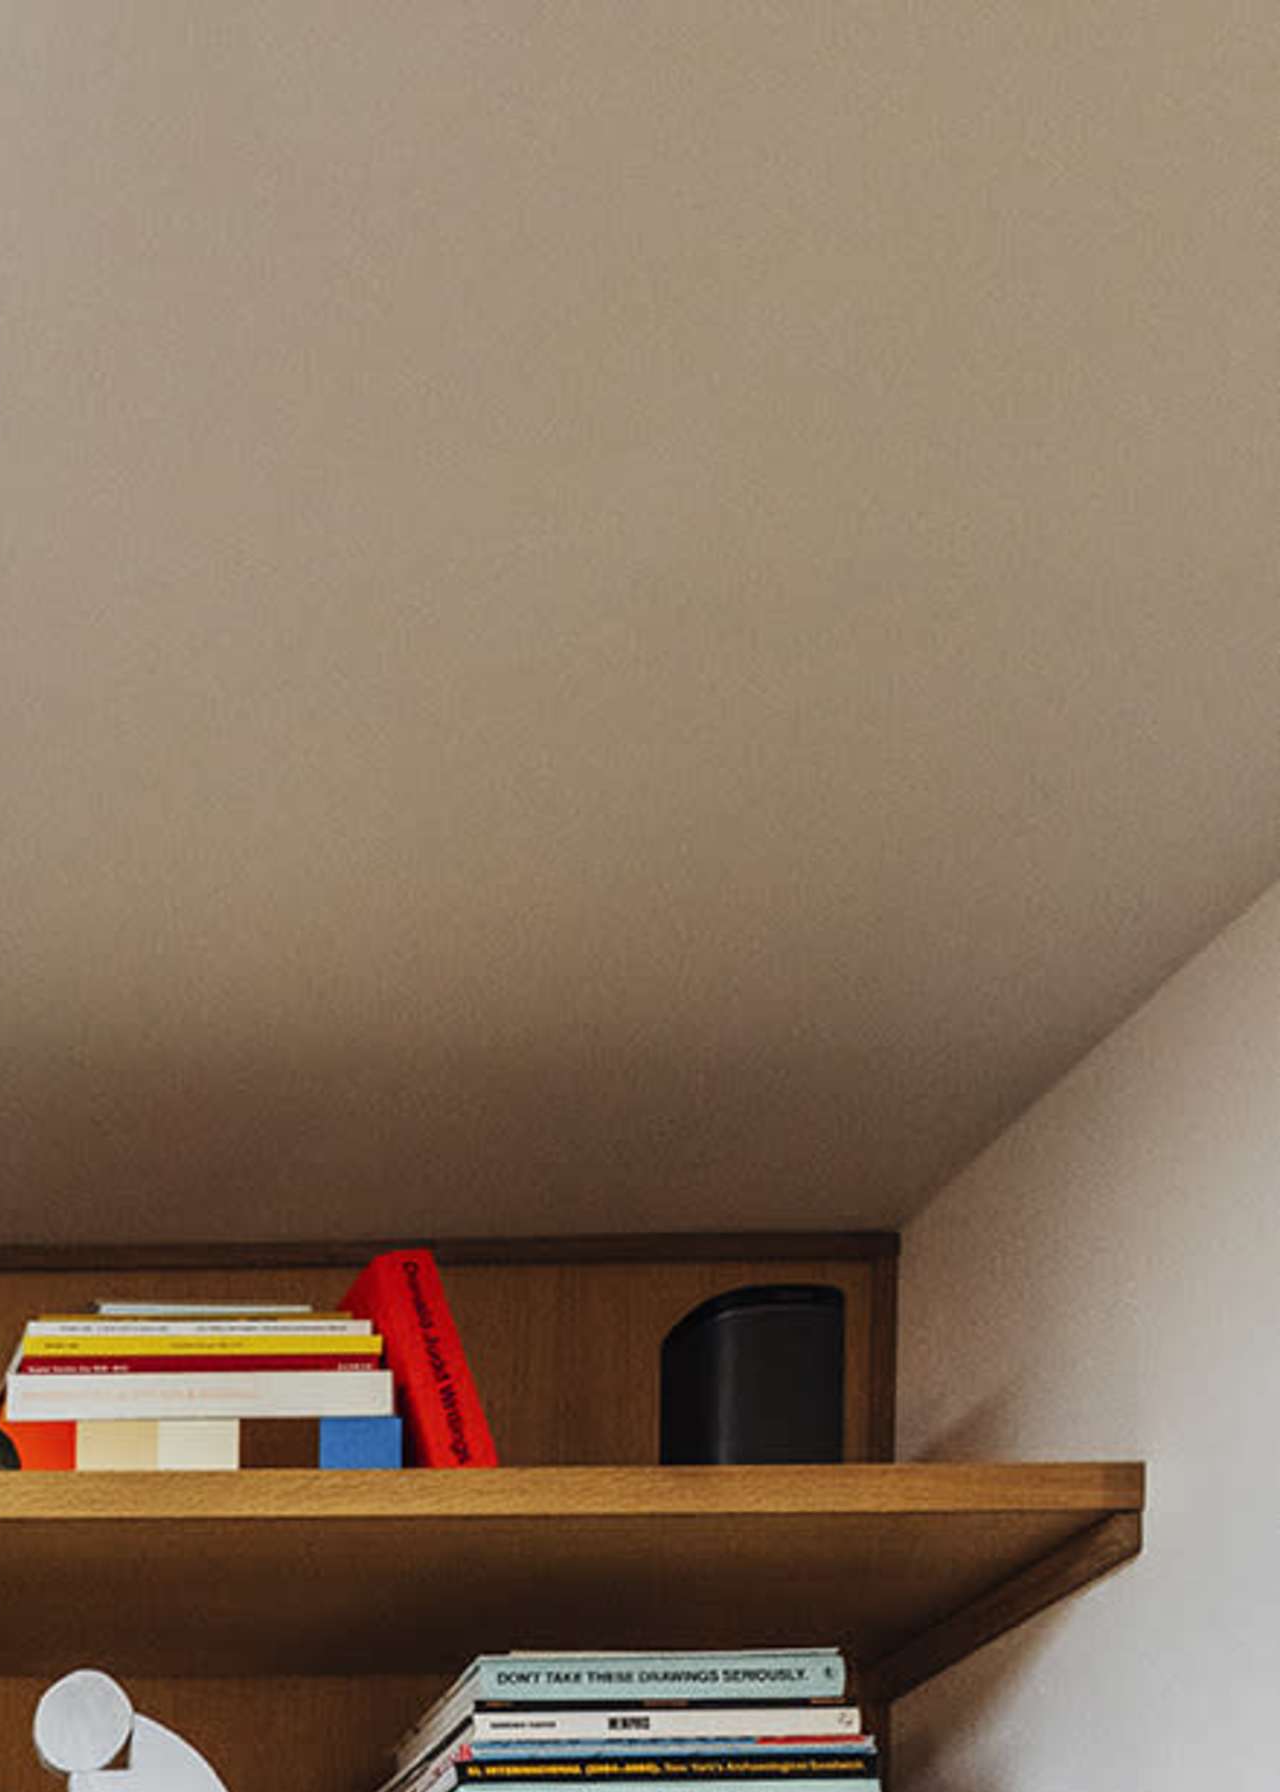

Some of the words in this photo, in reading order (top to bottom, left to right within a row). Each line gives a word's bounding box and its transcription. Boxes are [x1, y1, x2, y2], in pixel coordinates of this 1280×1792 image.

[496, 1672, 540, 1685] DON'T
[546, 1671, 582, 1685] TAKE
[586, 1670, 633, 1684] THESE
[635, 1669, 720, 1684] DRAWINGS
